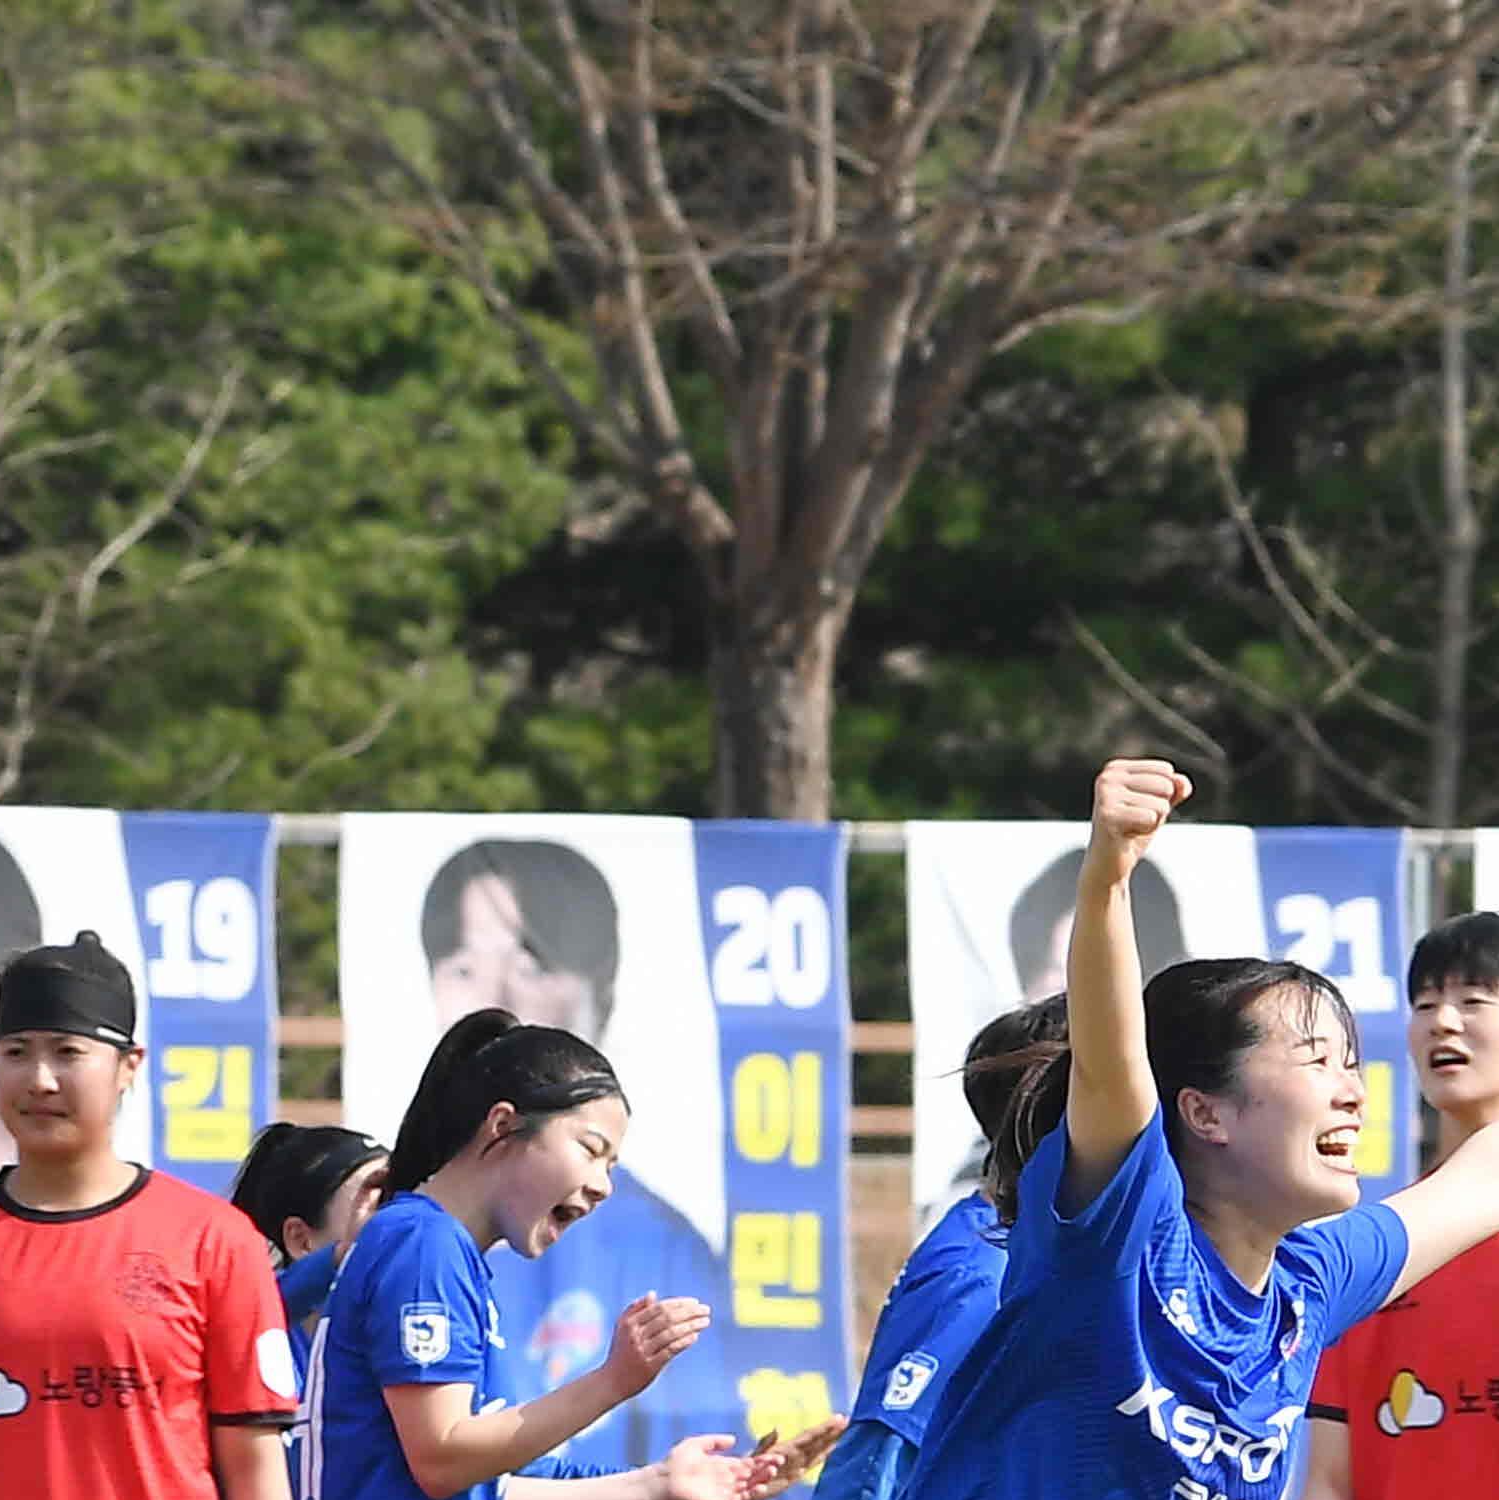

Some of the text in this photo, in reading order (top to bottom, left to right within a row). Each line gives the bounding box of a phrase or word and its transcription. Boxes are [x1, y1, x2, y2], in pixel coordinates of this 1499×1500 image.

[145, 877, 258, 1001] 19
[711, 885, 831, 1009] 20
[1276, 893, 1397, 1013] 21
[1115, 1374, 1284, 1483] KSPO
